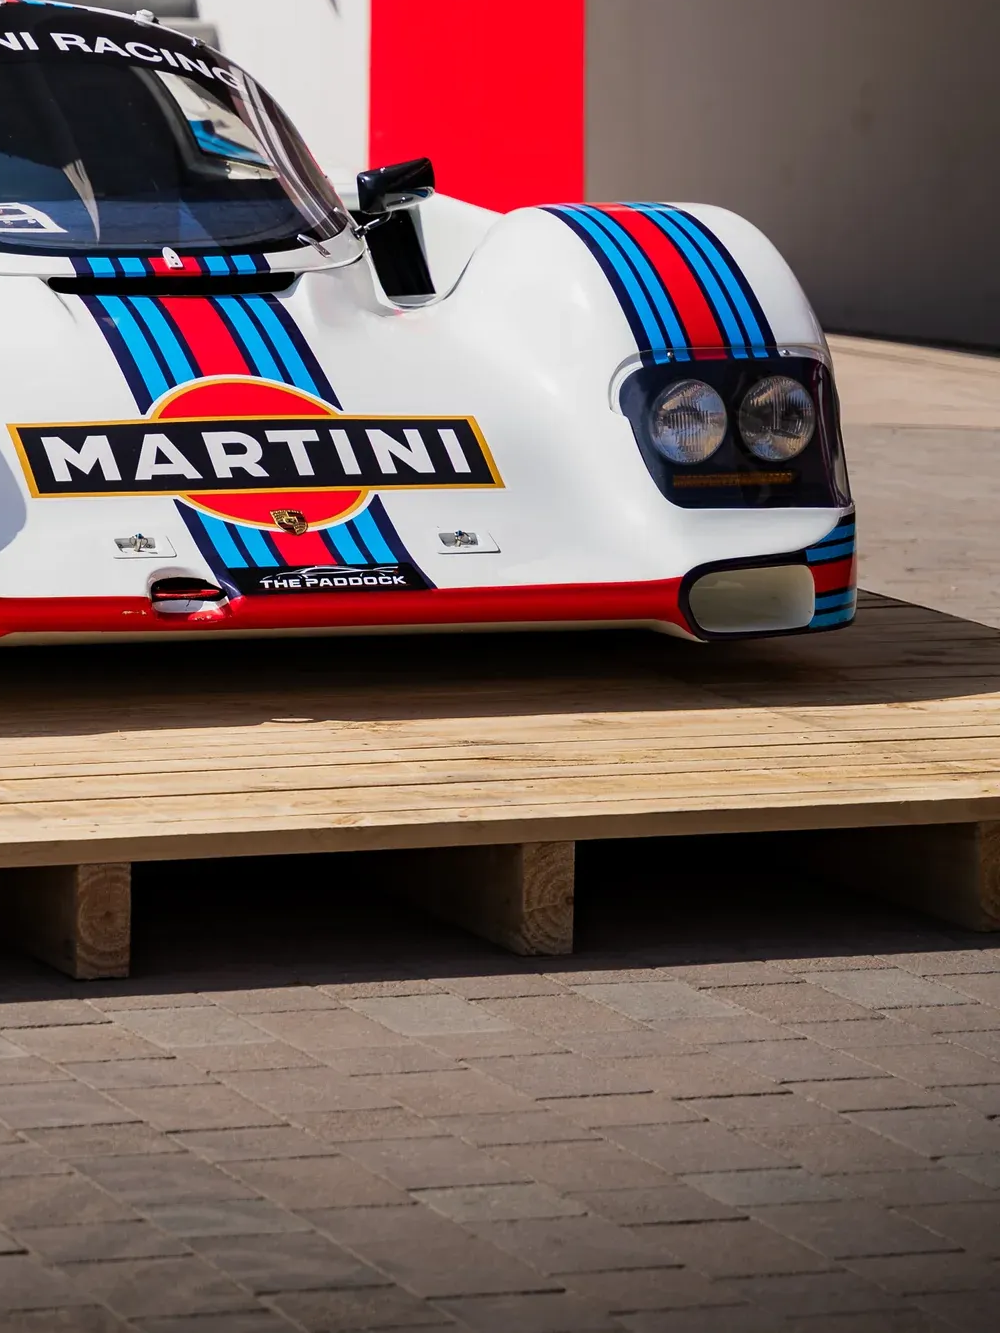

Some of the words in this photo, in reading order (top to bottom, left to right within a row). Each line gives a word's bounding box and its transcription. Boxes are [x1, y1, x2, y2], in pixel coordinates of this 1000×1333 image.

[50, 32, 248, 93] RACING
[40, 428, 472, 483] MARTINI
[259, 578, 302, 589] THE
[305, 575, 407, 588] PADDOCK
